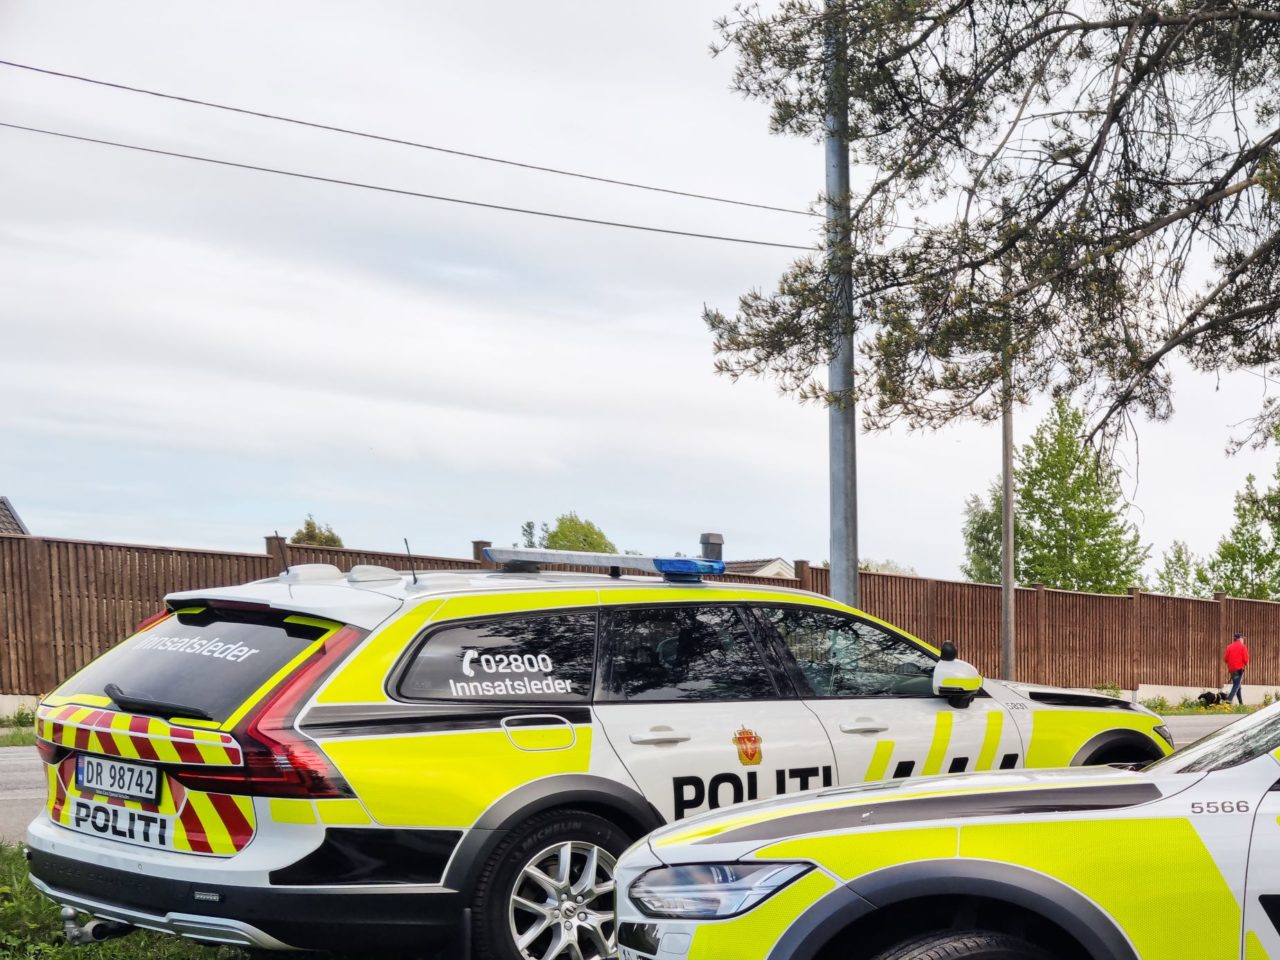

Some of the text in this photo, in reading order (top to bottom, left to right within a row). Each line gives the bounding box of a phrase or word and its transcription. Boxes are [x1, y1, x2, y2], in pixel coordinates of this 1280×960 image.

[480, 654, 553, 673] 02800
[449, 676, 572, 696] Innsatsleder
[86, 760, 103, 786] DR
[109, 764, 154, 795] 98742
[1191, 800, 1250, 814] 5566
[75, 801, 167, 846] POLITI
